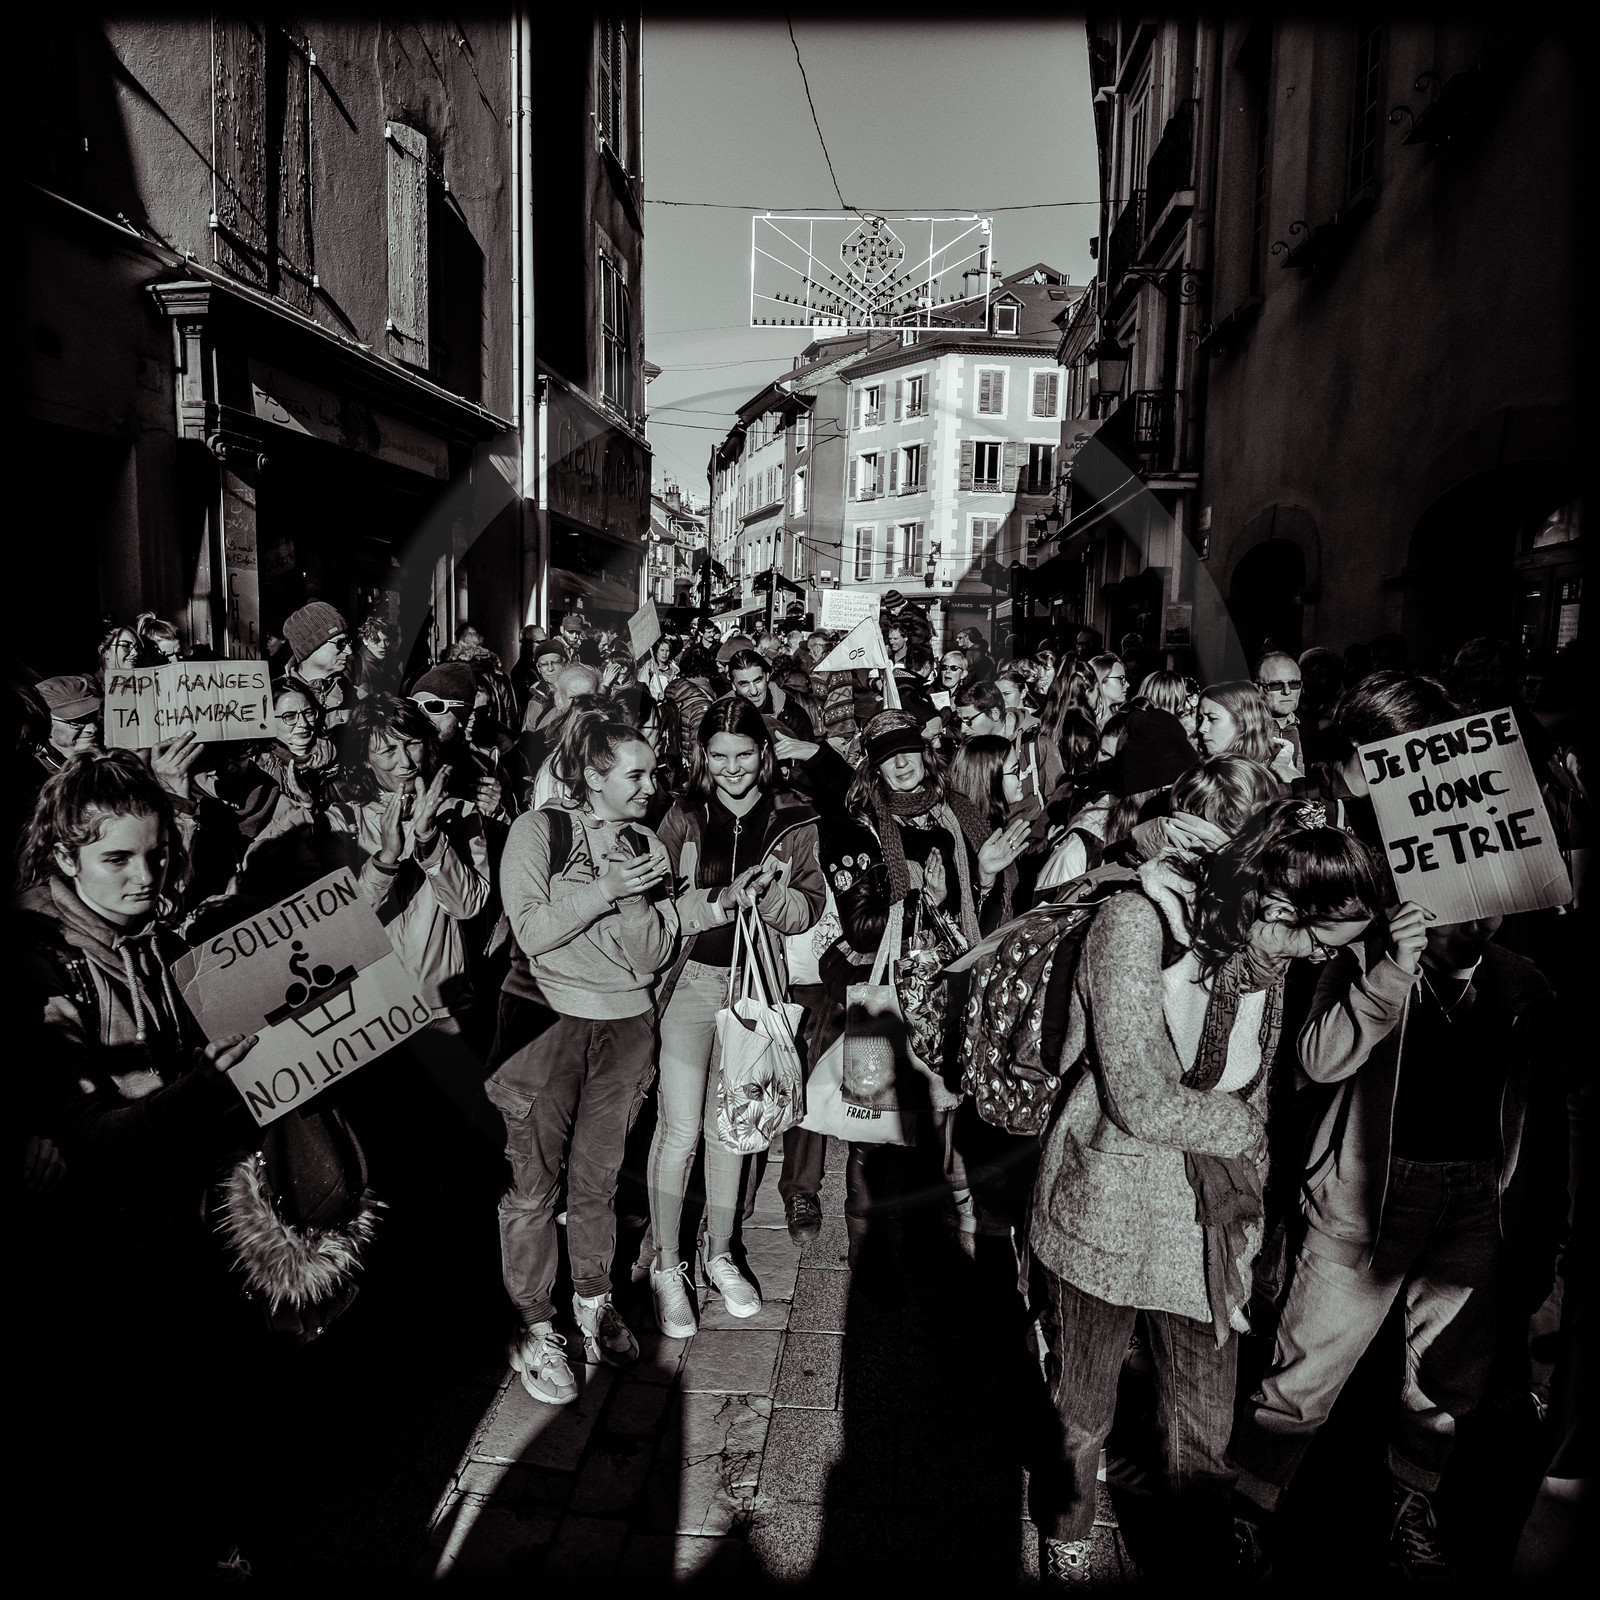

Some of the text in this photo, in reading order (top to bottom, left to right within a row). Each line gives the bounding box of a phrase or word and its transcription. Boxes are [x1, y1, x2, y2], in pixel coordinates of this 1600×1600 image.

[176, 672, 265, 692] RANGES
[113, 708, 140, 728] TA
[1405, 712, 1519, 773] PENSE
